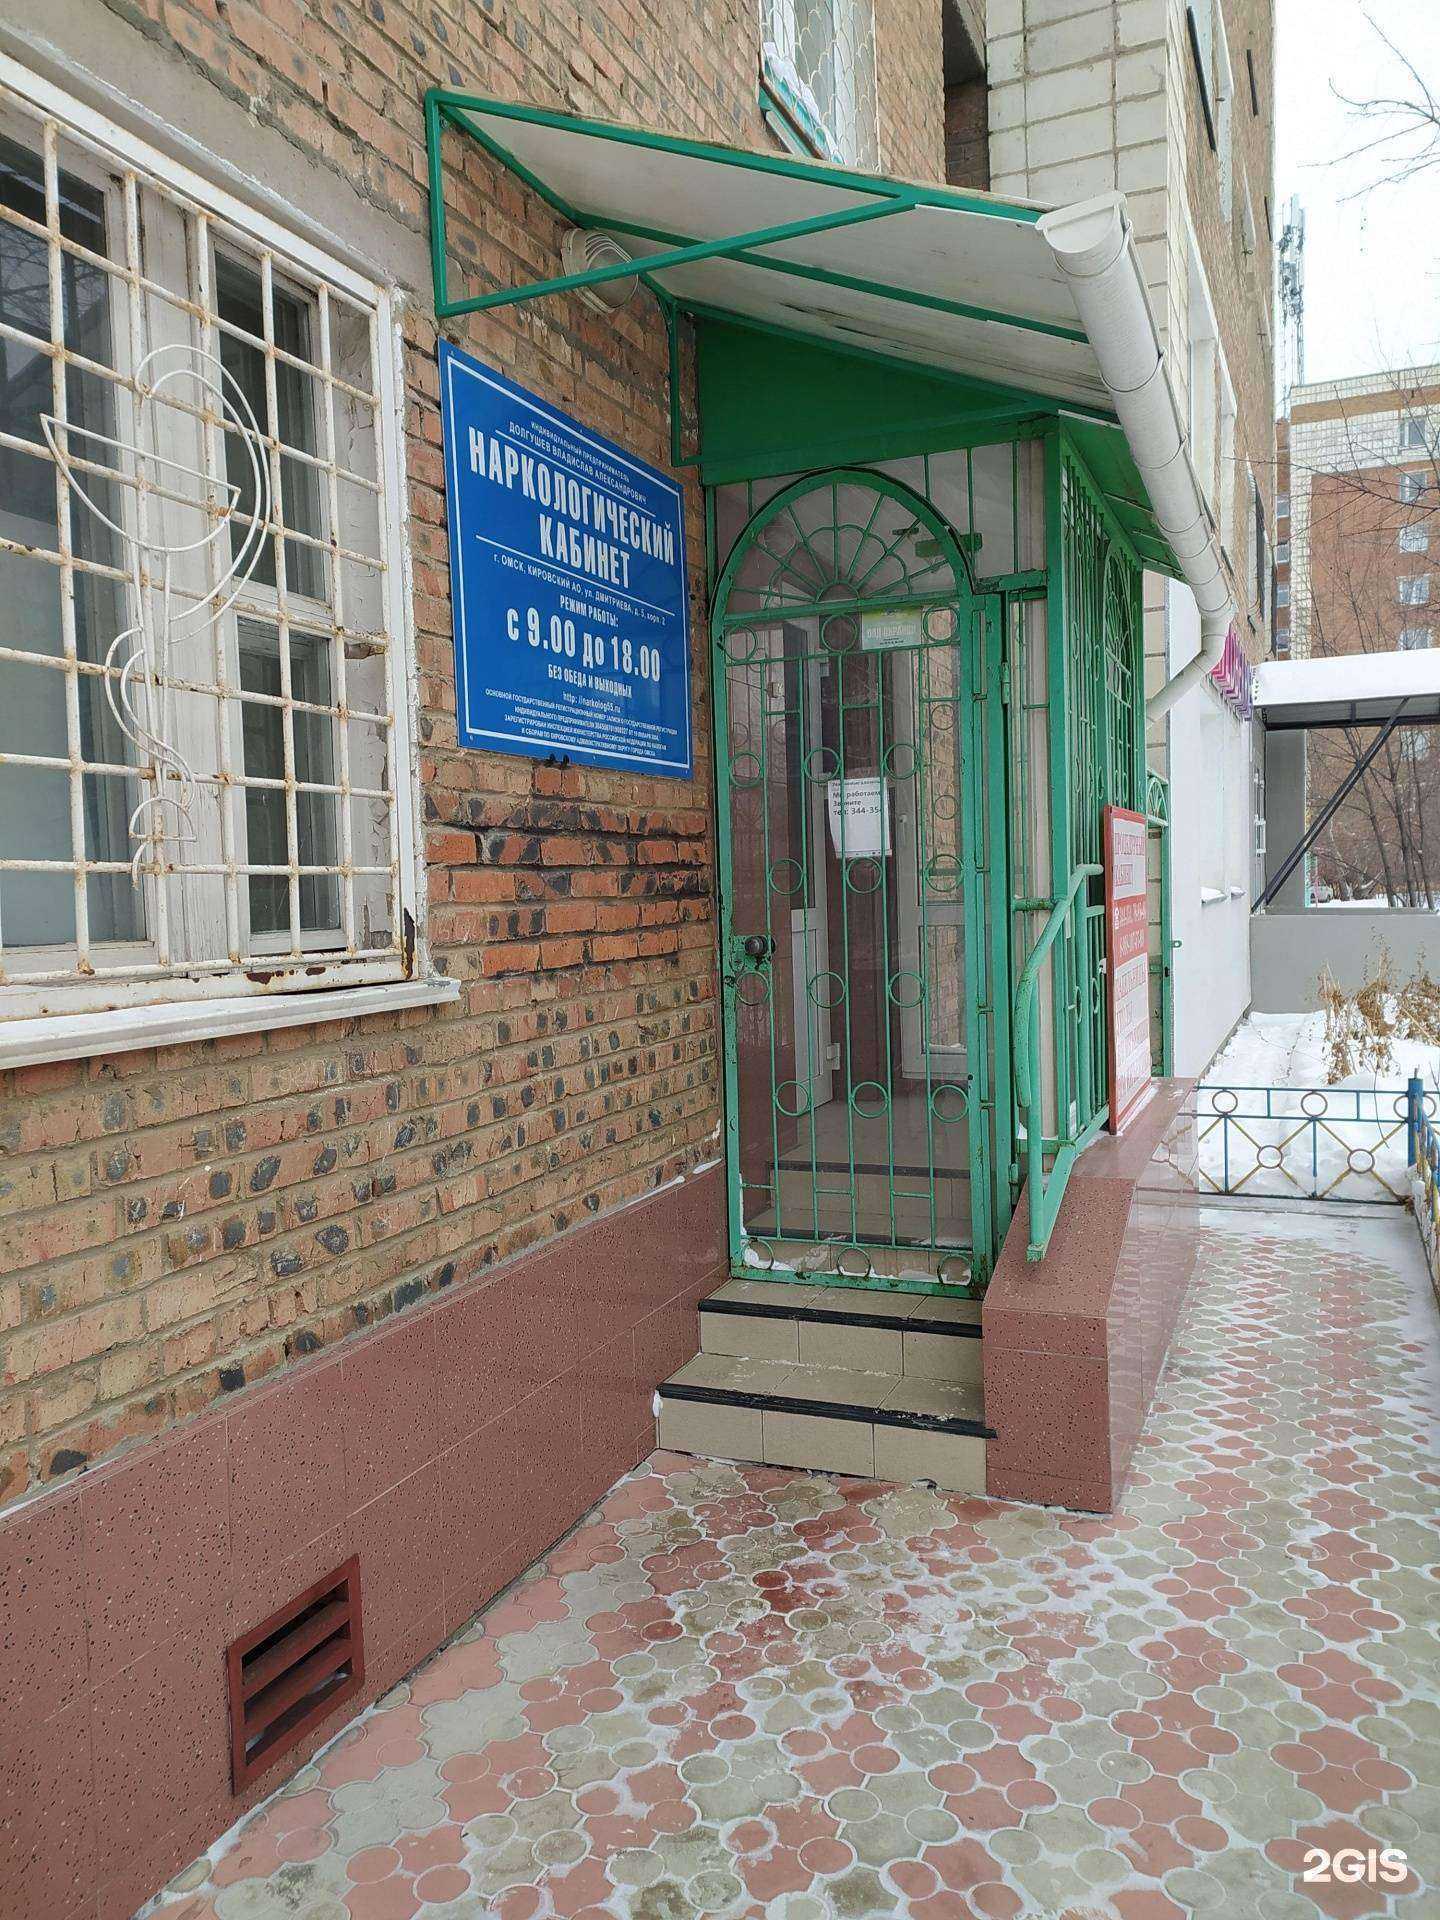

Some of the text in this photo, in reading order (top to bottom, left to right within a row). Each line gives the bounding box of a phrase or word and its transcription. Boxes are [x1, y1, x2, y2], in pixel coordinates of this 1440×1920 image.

[531, 421, 581, 455] ИНДИВИДУАЛЬНЫЙ
[510, 421, 647, 504] ДОЛГУШЕВ ВЛАДИСЛАВ АЛЕКСАНДРОВИЧ
[468, 425, 674, 565] НАРКОЛОГИЧЕСКИЙ
[539, 513, 630, 588] КАБИНЕТ
[501, 554, 526, 574] ОМСК,
[527, 564, 571, 589] КИРОВСКИЙ
[560, 594, 619, 628] РЕЖИМ РАБОТЫ:
[527, 607, 575, 658] 9.00
[583, 632, 605, 669] до
[611, 635, 661, 682] 18.00
[548, 663, 633, 699] БЕЗ ОБЕДА И ВЫХОДНЫХ
[847, 790, 881, 799] работаем
